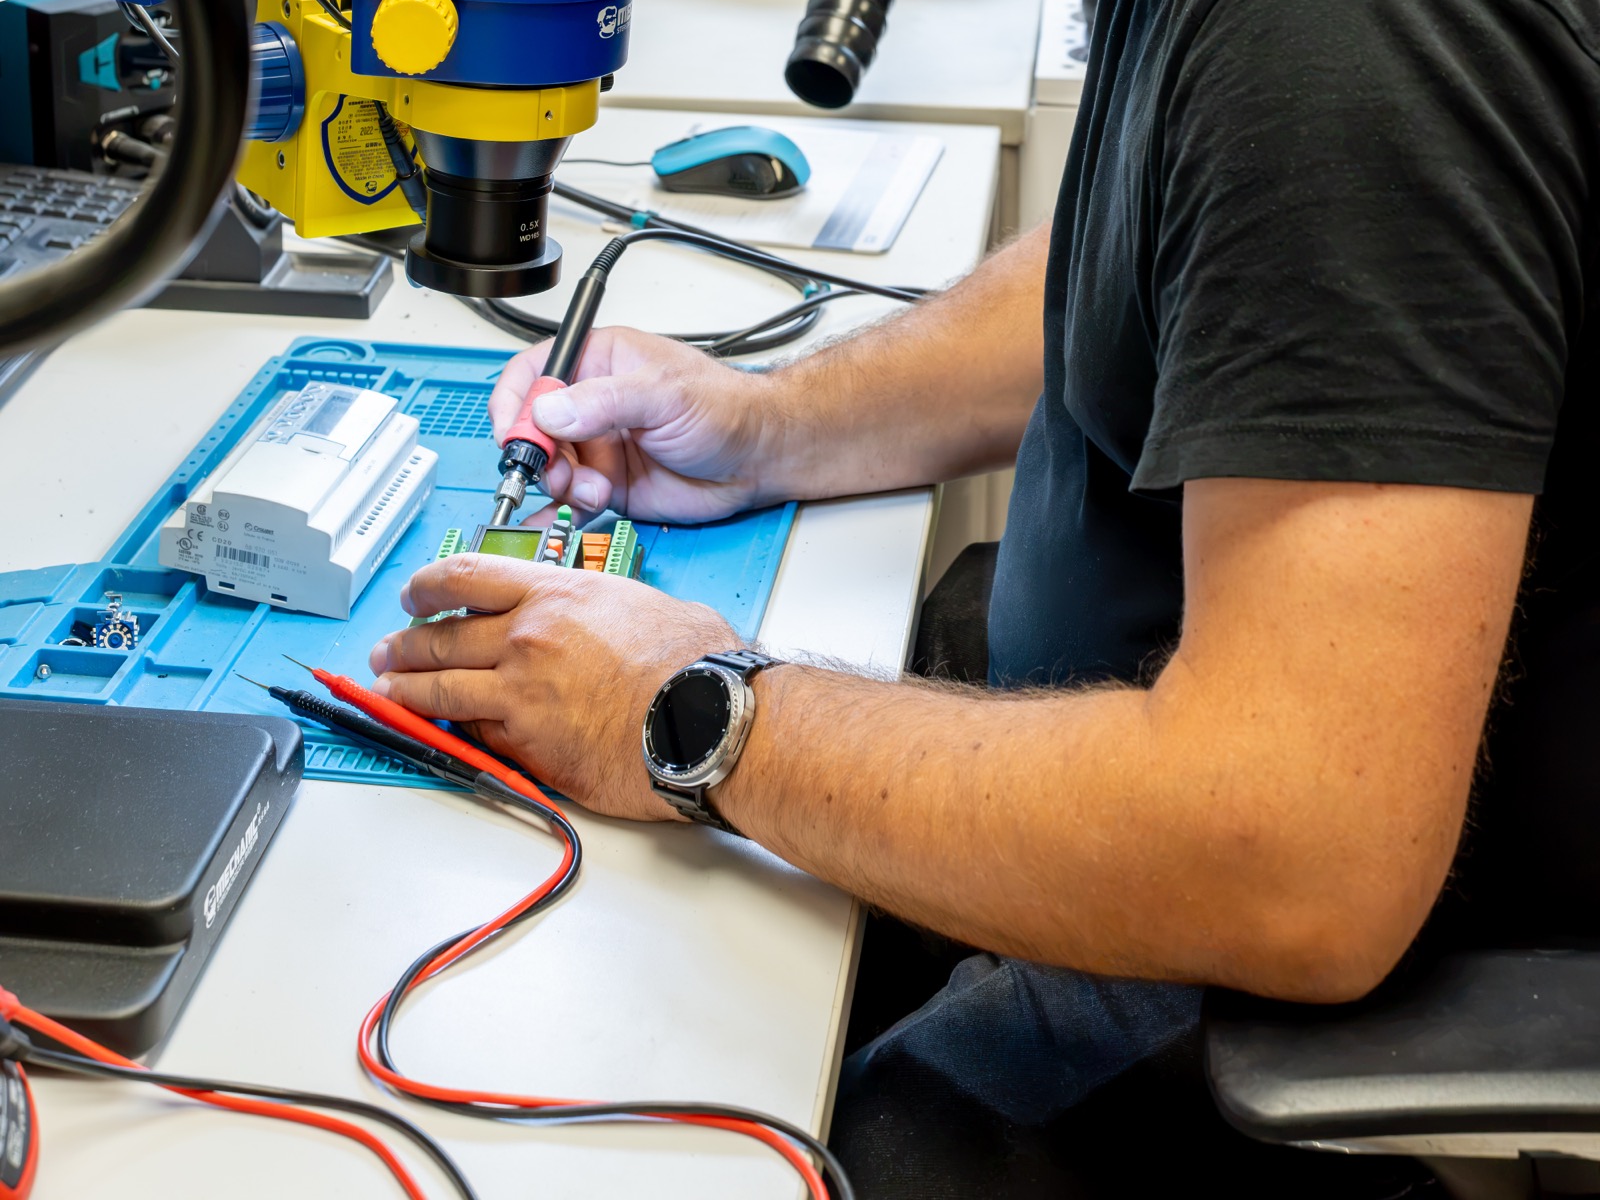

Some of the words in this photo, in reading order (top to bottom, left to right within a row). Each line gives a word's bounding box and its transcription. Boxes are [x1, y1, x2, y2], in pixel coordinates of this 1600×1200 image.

[520, 220, 540, 231] 0.5X
[212, 536, 232, 546] CD20
[216, 812, 260, 903] MECHANIC
